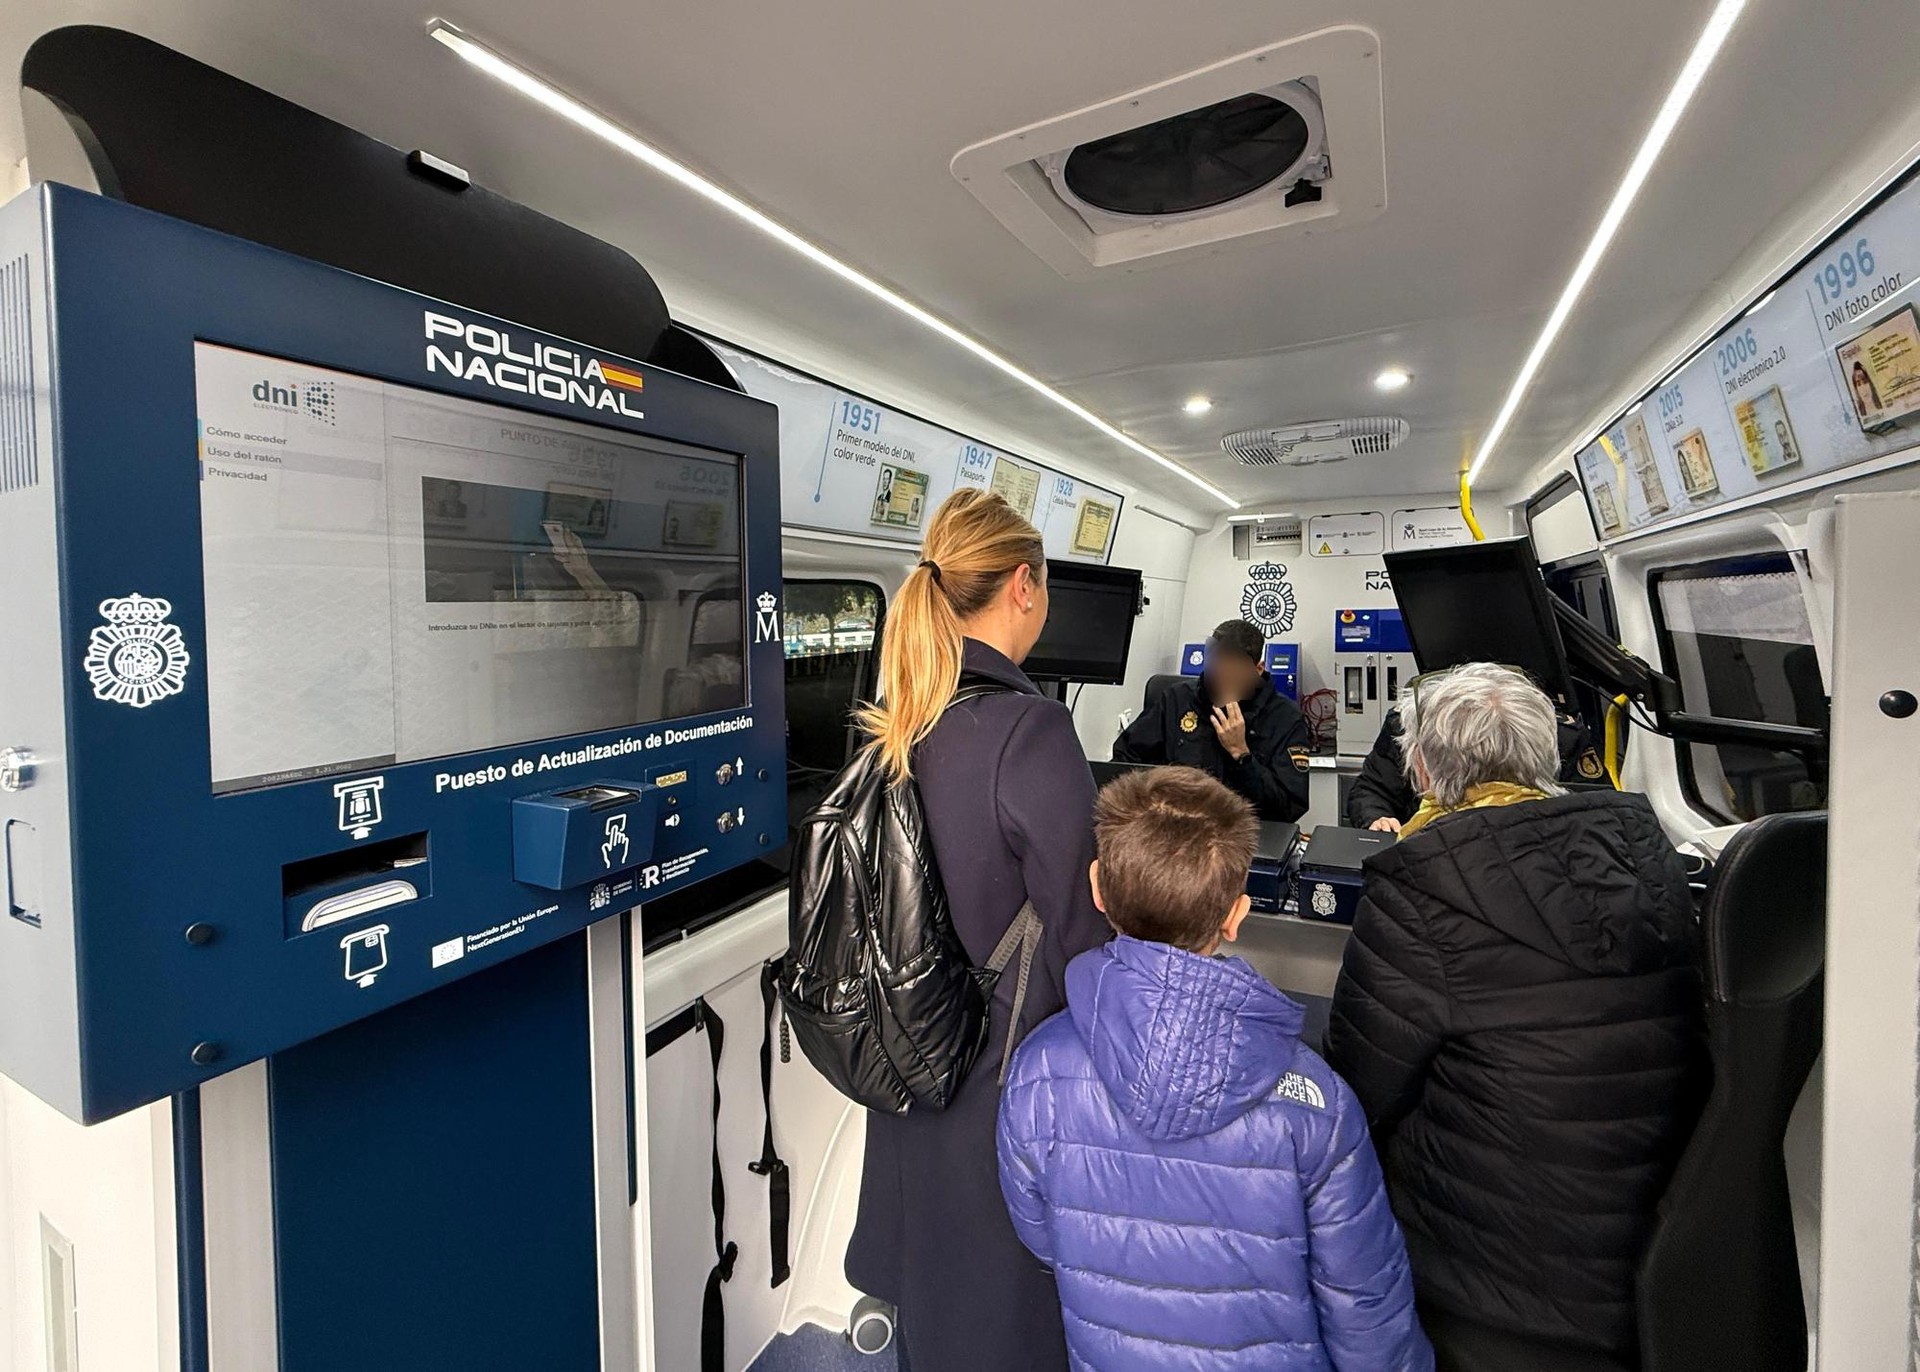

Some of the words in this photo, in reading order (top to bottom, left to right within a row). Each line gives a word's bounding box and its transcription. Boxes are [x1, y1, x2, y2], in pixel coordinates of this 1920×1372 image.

[1814, 238, 1875, 305] 1996
[1824, 306, 1845, 331] DNI
[1845, 295, 1869, 318] foto
[1871, 272, 1902, 302] color
[1718, 327, 1757, 376] 2006
[1773, 345, 1786, 364] 2.0
[252, 380, 298, 407] dni
[425, 344, 645, 420] NACIONAL
[1659, 383, 1684, 418] 2015
[842, 401, 881, 434] 1951
[244, 432, 288, 445] acceder
[500, 427, 541, 445] PUNTO
[836, 428, 862, 447] Primer
[863, 441, 890, 455] modelo
[891, 446, 902, 459] del
[207, 446, 231, 458] Uso
[234, 449, 252, 460] del
[833, 446, 854, 460] color
[855, 452, 876, 467] verde
[965, 445, 993, 470] 1947
[208, 466, 268, 481] Privacidad
[960, 466, 986, 483] Pasaporte
[1056, 477, 1074, 497] 1928
[428, 623, 468, 632] Introduzca
[435, 765, 506, 793] Puesto
[511, 758, 534, 778] de
[537, 737, 642, 772] Actualización
[645, 733, 662, 749] de
[665, 715, 754, 746] Documentación
[466, 926, 500, 943] Financiado
[500, 921, 511, 933] por
[518, 912, 536, 924] Unión
[536, 904, 559, 917] Europea
[467, 925, 525, 953] NextGenerationEU
[1277, 1085, 1307, 1102] FACE
[1278, 1077, 1306, 1093] ORTH
